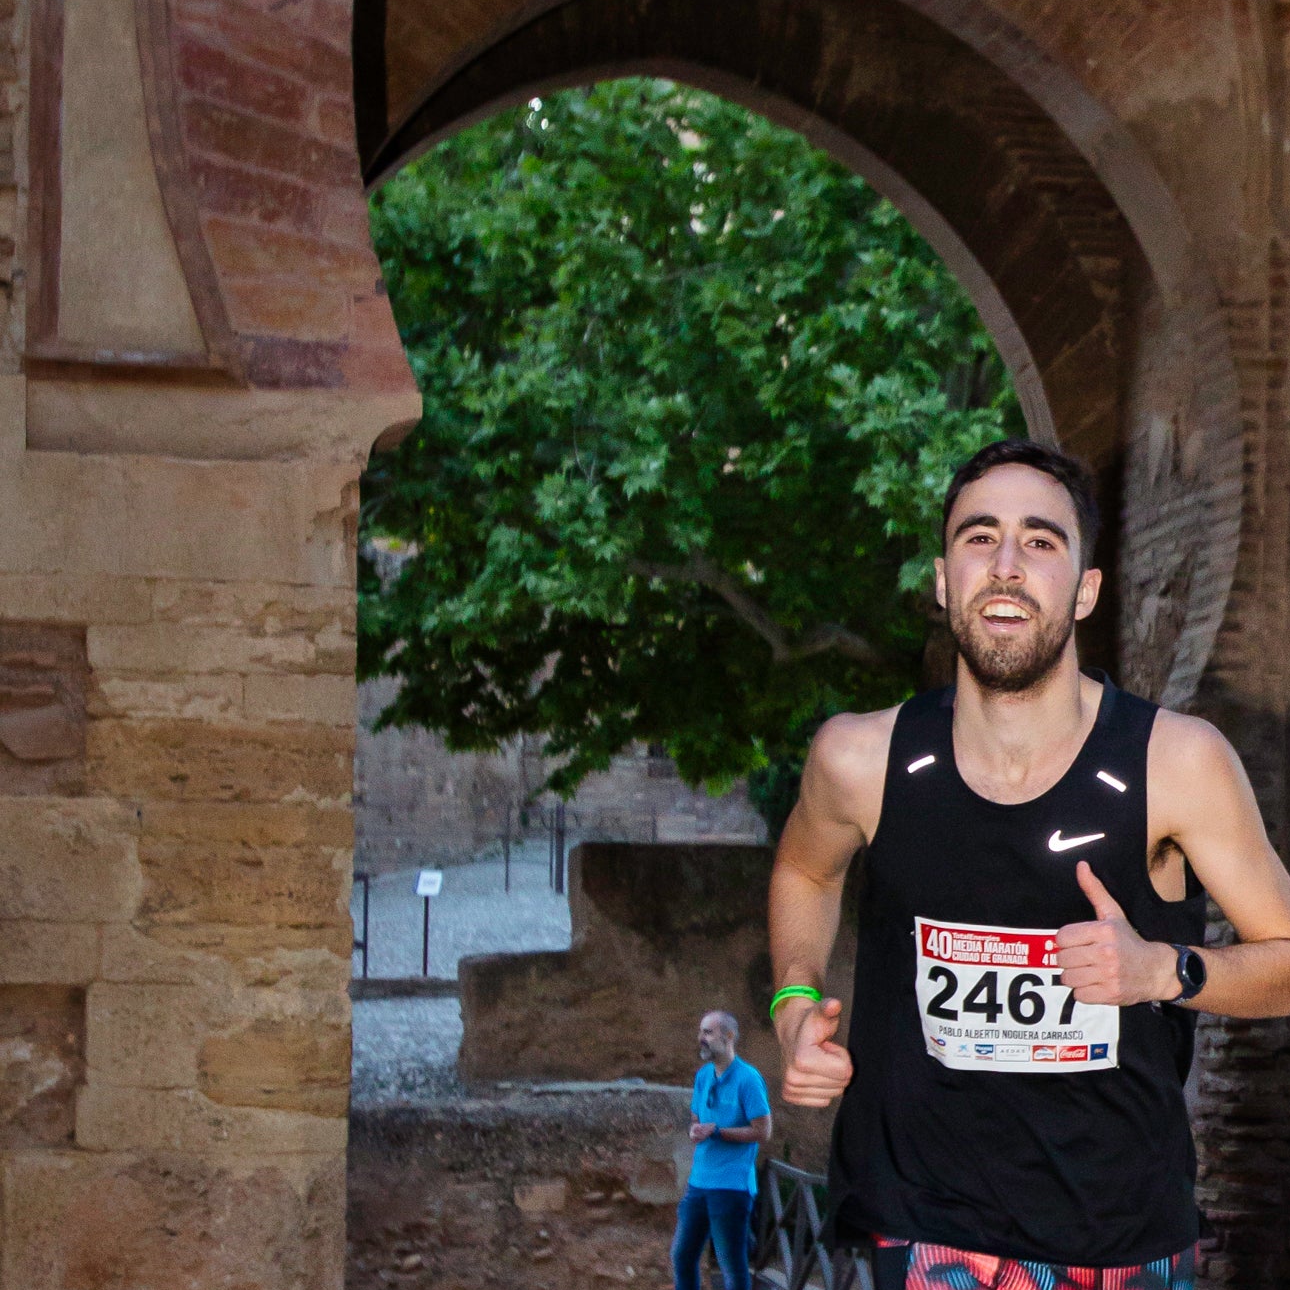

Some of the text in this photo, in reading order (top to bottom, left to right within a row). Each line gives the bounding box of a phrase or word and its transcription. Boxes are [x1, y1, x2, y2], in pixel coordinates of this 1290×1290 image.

[926, 929, 953, 959] 40
[952, 940, 1029, 956] MEDIA MARATÓN
[951, 951, 1028, 965] CIUDAD DE GRANADA
[927, 965, 1077, 1025] 2467
[939, 1025, 1084, 1040] PABLO ALBERTO NOGUERA CARRASCO
